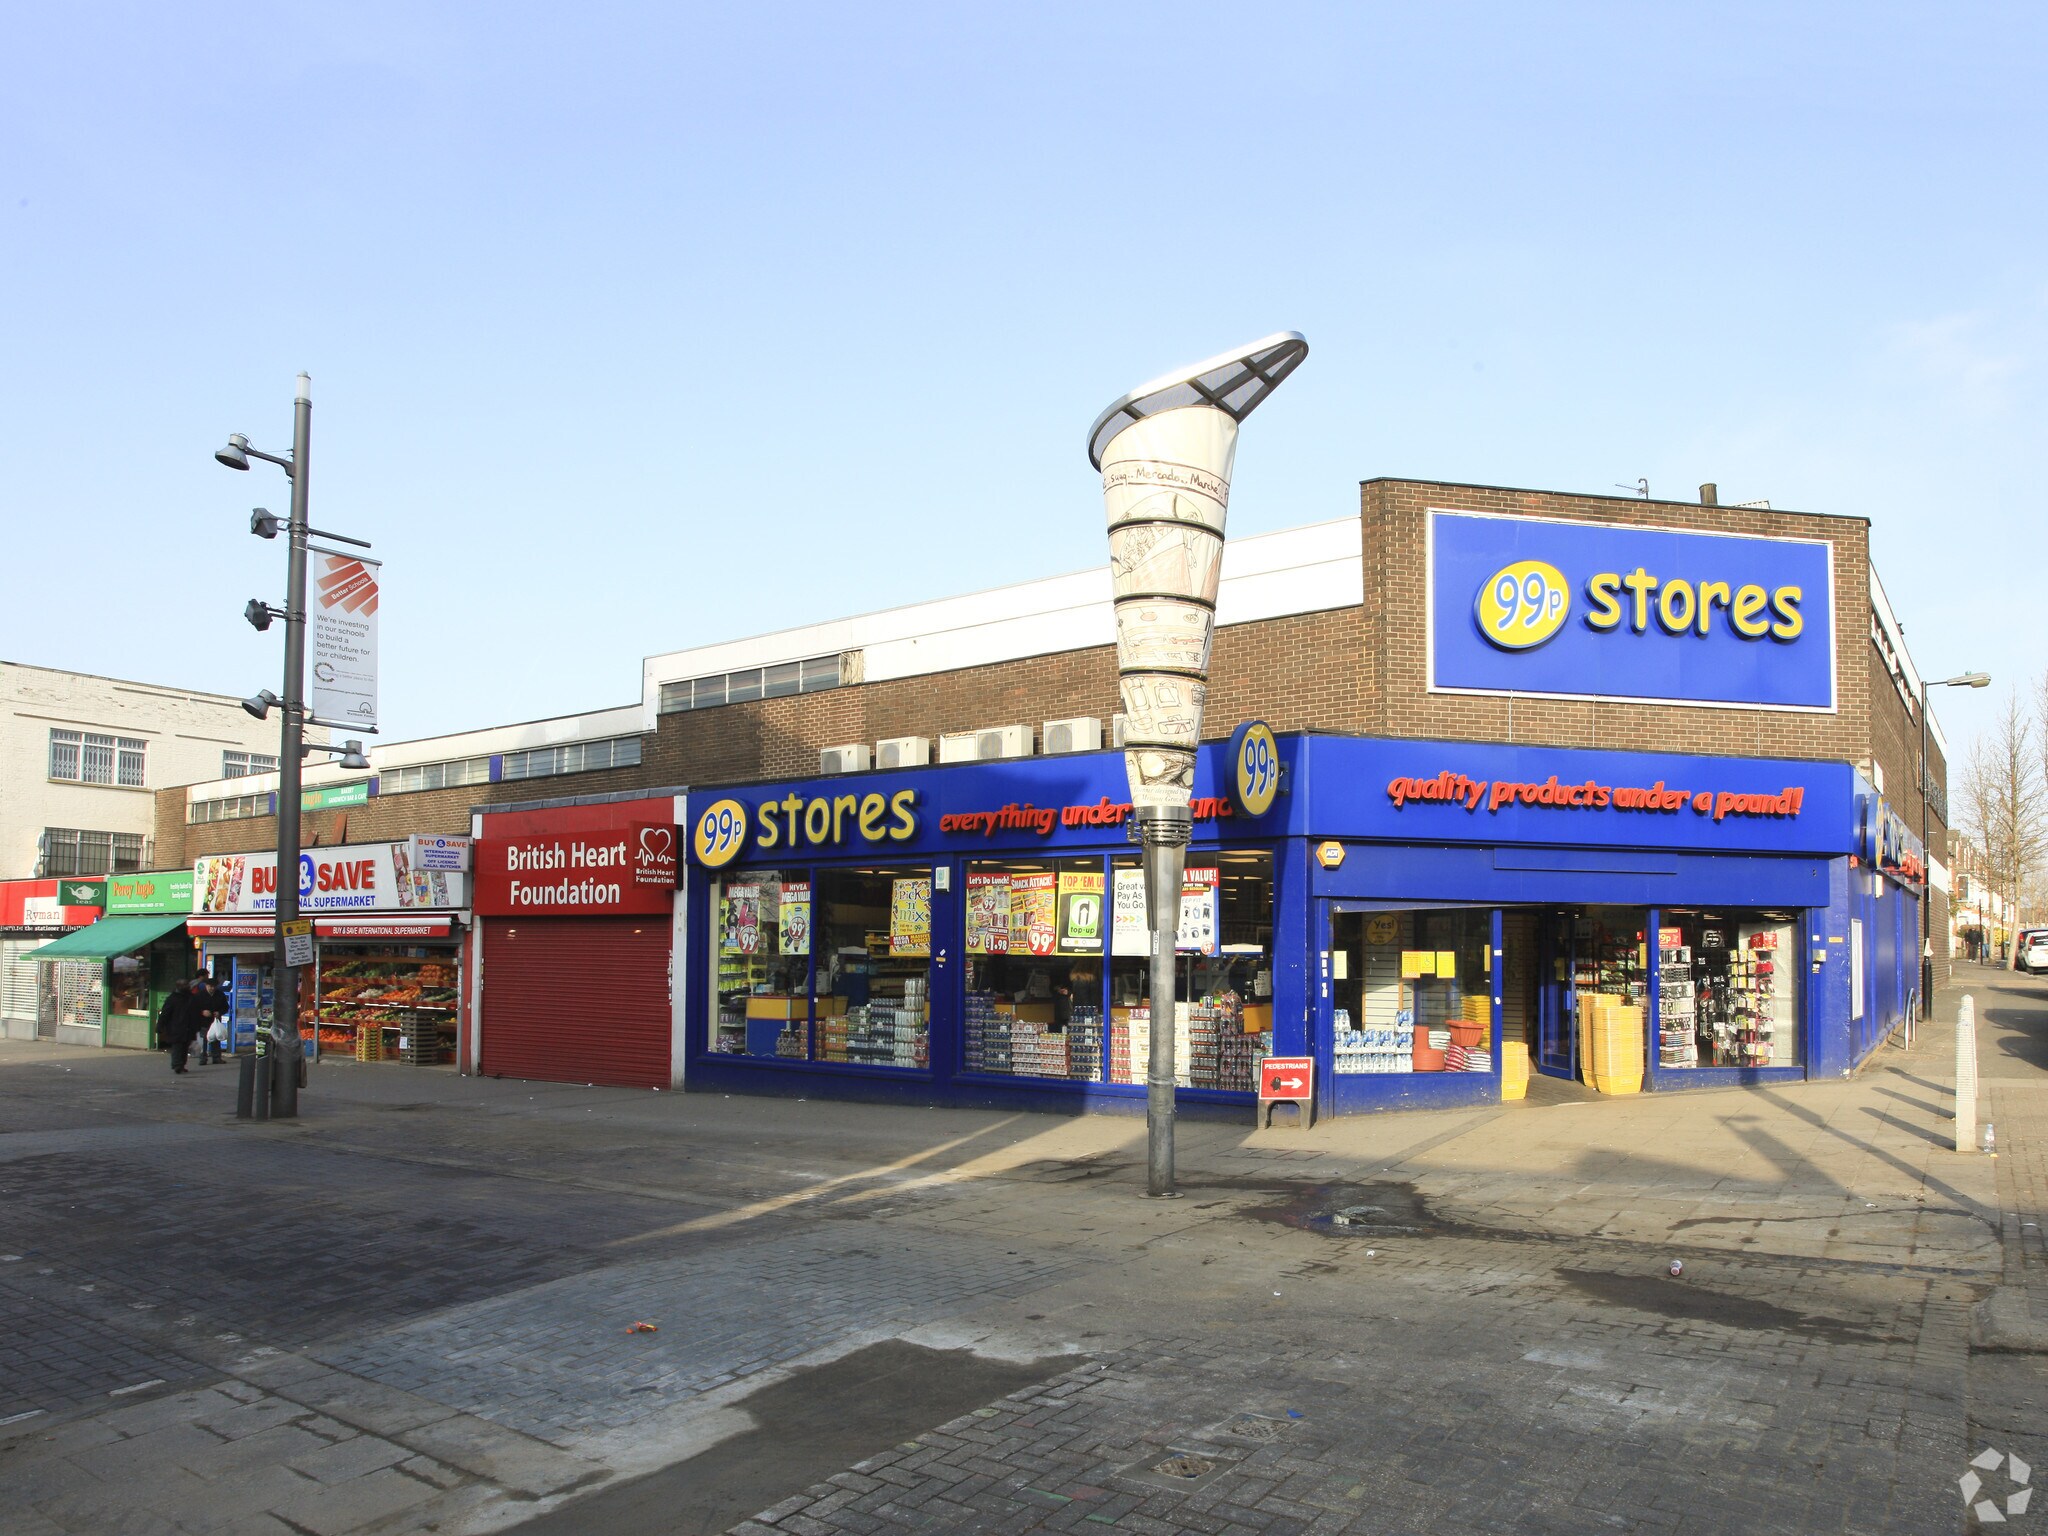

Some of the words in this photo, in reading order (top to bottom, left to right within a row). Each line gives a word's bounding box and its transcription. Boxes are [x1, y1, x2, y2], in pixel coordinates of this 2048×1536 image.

[331, 589, 349, 599] Better
[348, 577, 368, 590] Schools
[1494, 571, 1561, 630] 99p
[1584, 567, 1804, 640] stores
[317, 615, 336, 623] We're
[339, 619, 369, 630] investing
[326, 634, 342, 642] build
[339, 628, 365, 638] schools
[317, 641, 337, 650] better
[339, 645, 358, 654] future
[330, 653, 359, 662] children.
[1245, 738, 1275, 797] 99p
[1388, 770, 1486, 809] quality
[1489, 776, 1611, 810] products
[1612, 781, 1690, 811] under
[1693, 792, 1711, 811] a
[1714, 787, 1804, 820] pound!
[704, 808, 742, 856] 99p
[757, 790, 917, 847] stores
[939, 803, 1057, 837] everything
[1061, 796, 1133, 826] under
[507, 842, 565, 871] British
[571, 842, 626, 868] Heart
[252, 866, 277, 893] BU
[318, 860, 375, 891] SAVE
[636, 876, 674, 884] Foundation
[1029, 875, 1052, 888] ATTACK!
[1063, 876, 1078, 887] TOP
[1190, 869, 1217, 882] VALUE!
[113, 882, 133, 899] Percy
[136, 881, 154, 899] Ingle
[511, 877, 620, 905] Foundation
[1117, 892, 1130, 901] Pay
[315, 895, 376, 907] SUPERMARKET
[782, 892, 797, 902] MEGA
[1132, 901, 1145, 909] Go.
[26, 910, 60, 922] Ryman
[1374, 919, 1394, 929] Yes!
[986, 935, 1007, 951] £1.98
[1659, 934, 1671, 944] 9p
